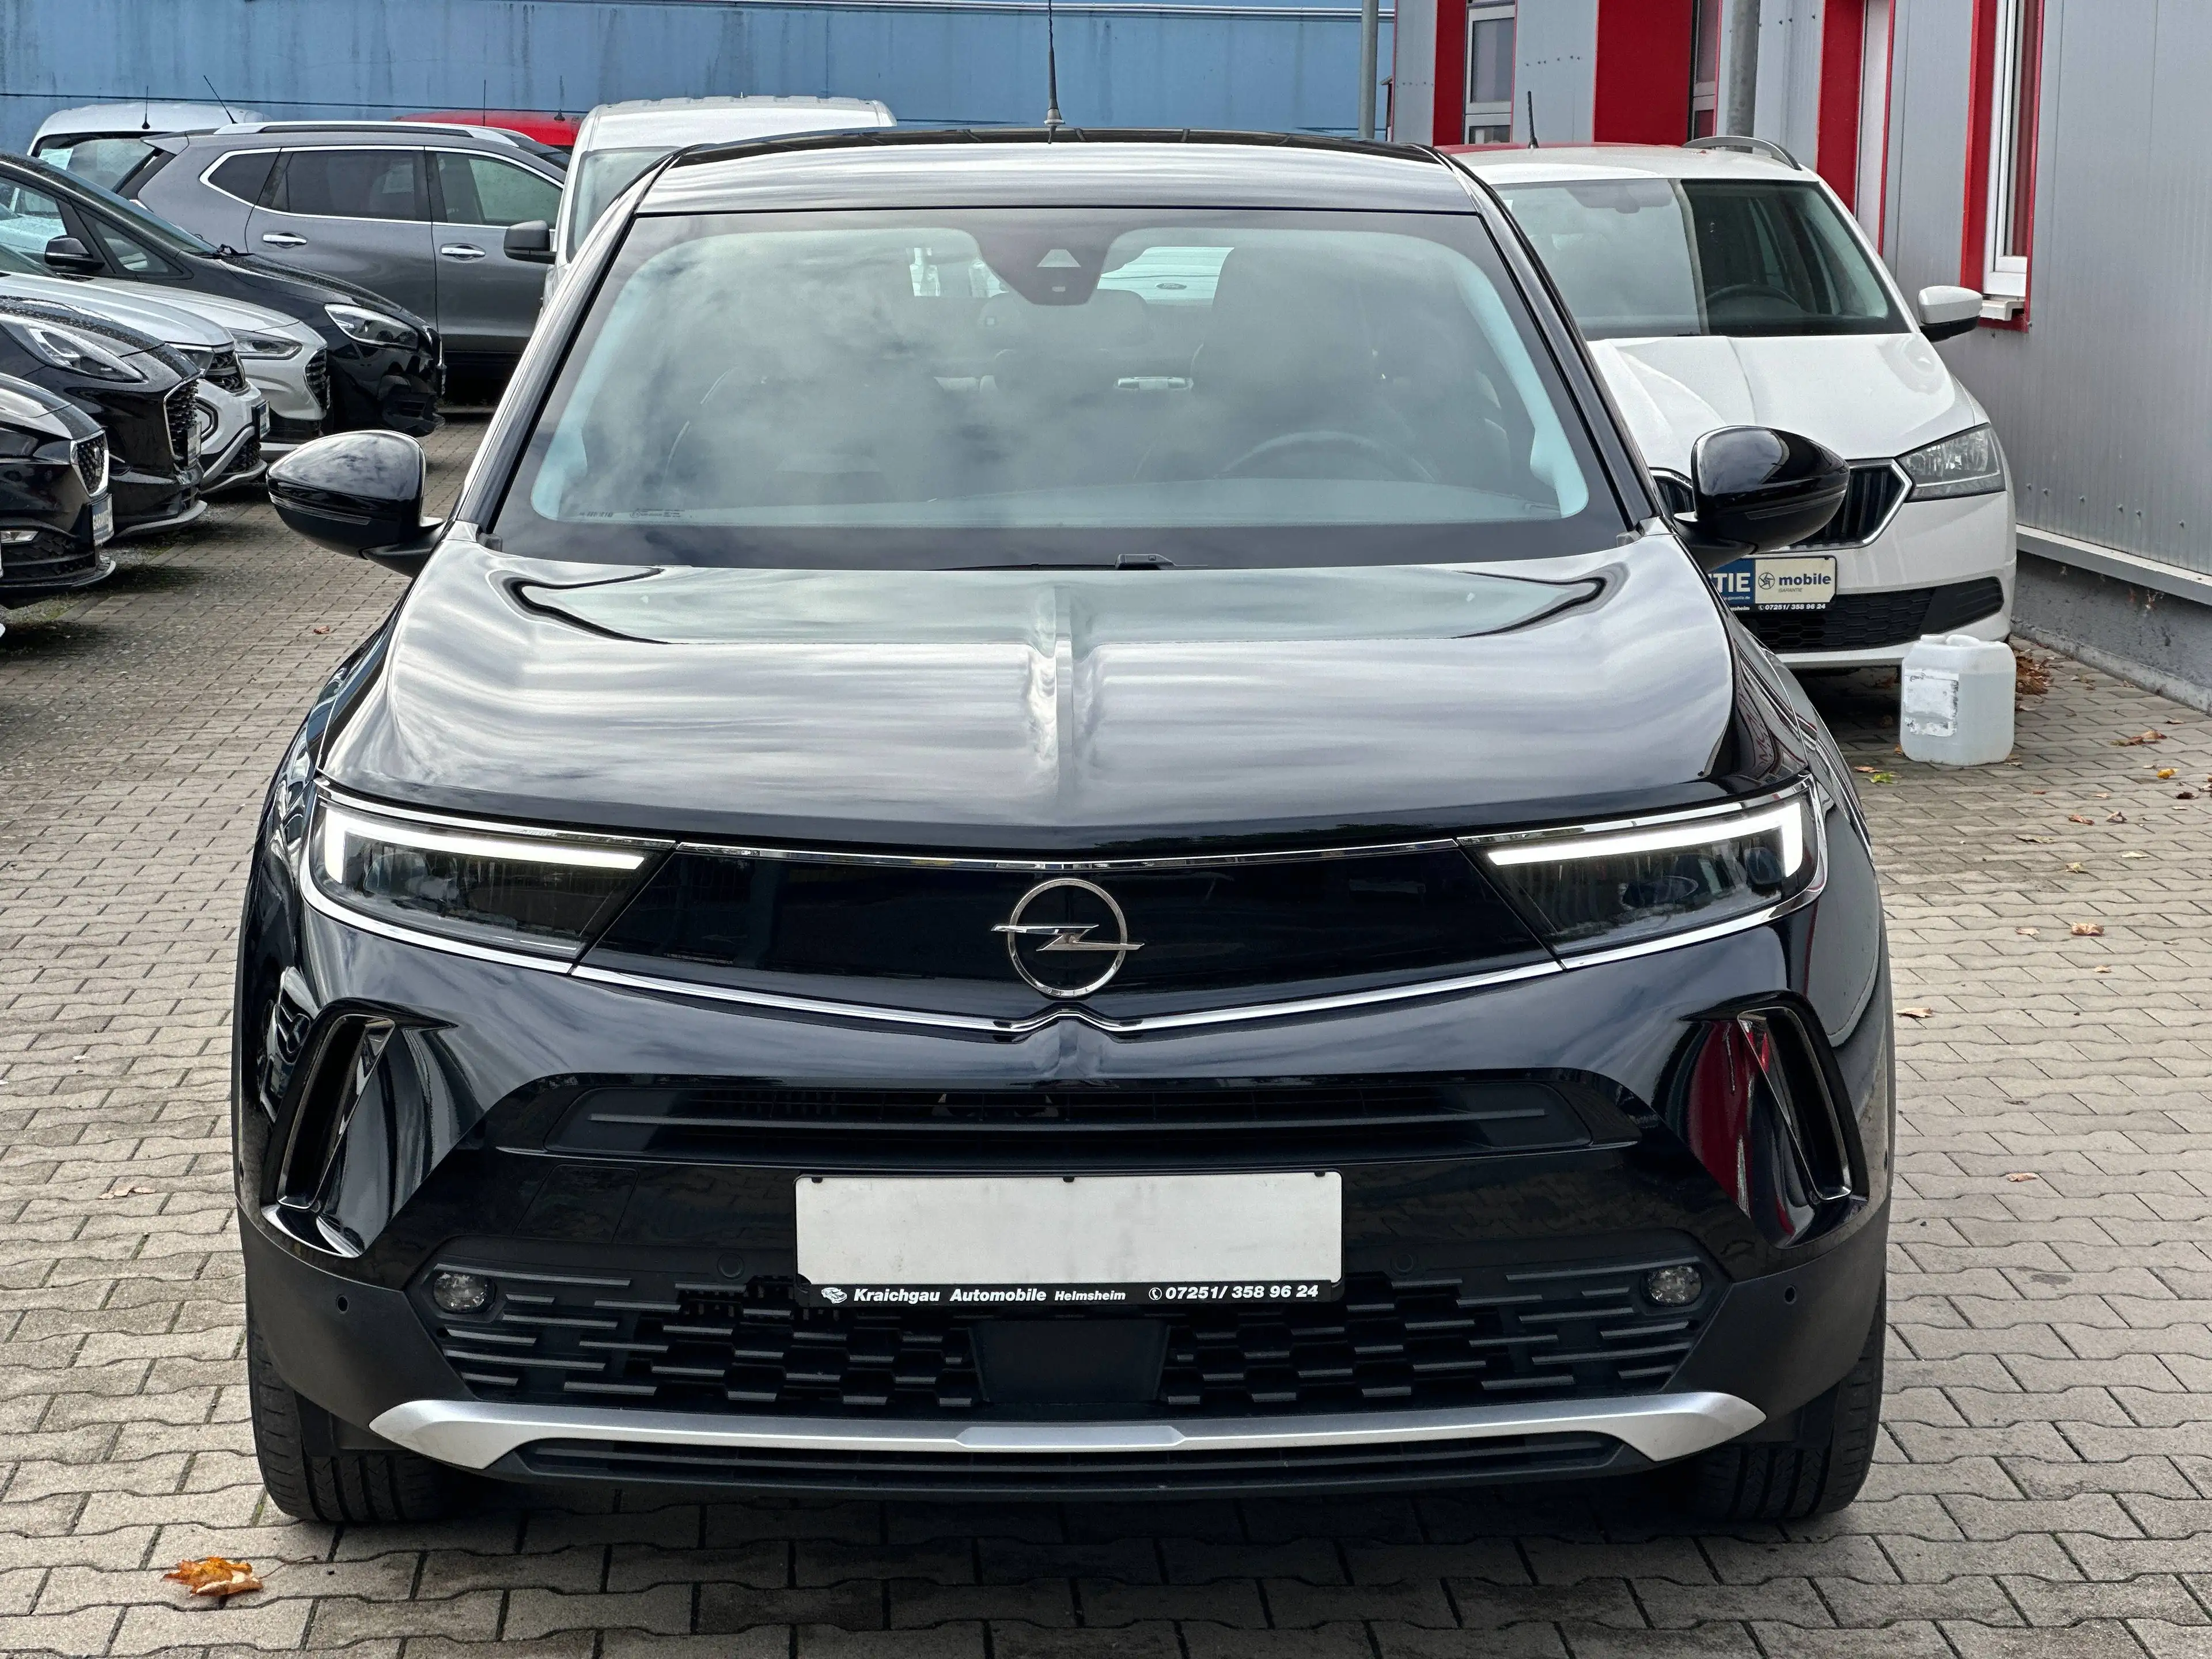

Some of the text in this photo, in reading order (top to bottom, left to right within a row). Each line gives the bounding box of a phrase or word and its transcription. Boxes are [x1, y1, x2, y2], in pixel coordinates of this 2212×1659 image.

[1709, 573, 1751, 593] TIE
[1778, 573, 1832, 586] mobile
[1046, 987, 1090, 997] OPEL
[853, 1288, 1126, 1304] Kraichgau Automobile Helmsheim
[1165, 1285, 1319, 1300] 07251/ 358 96 24
